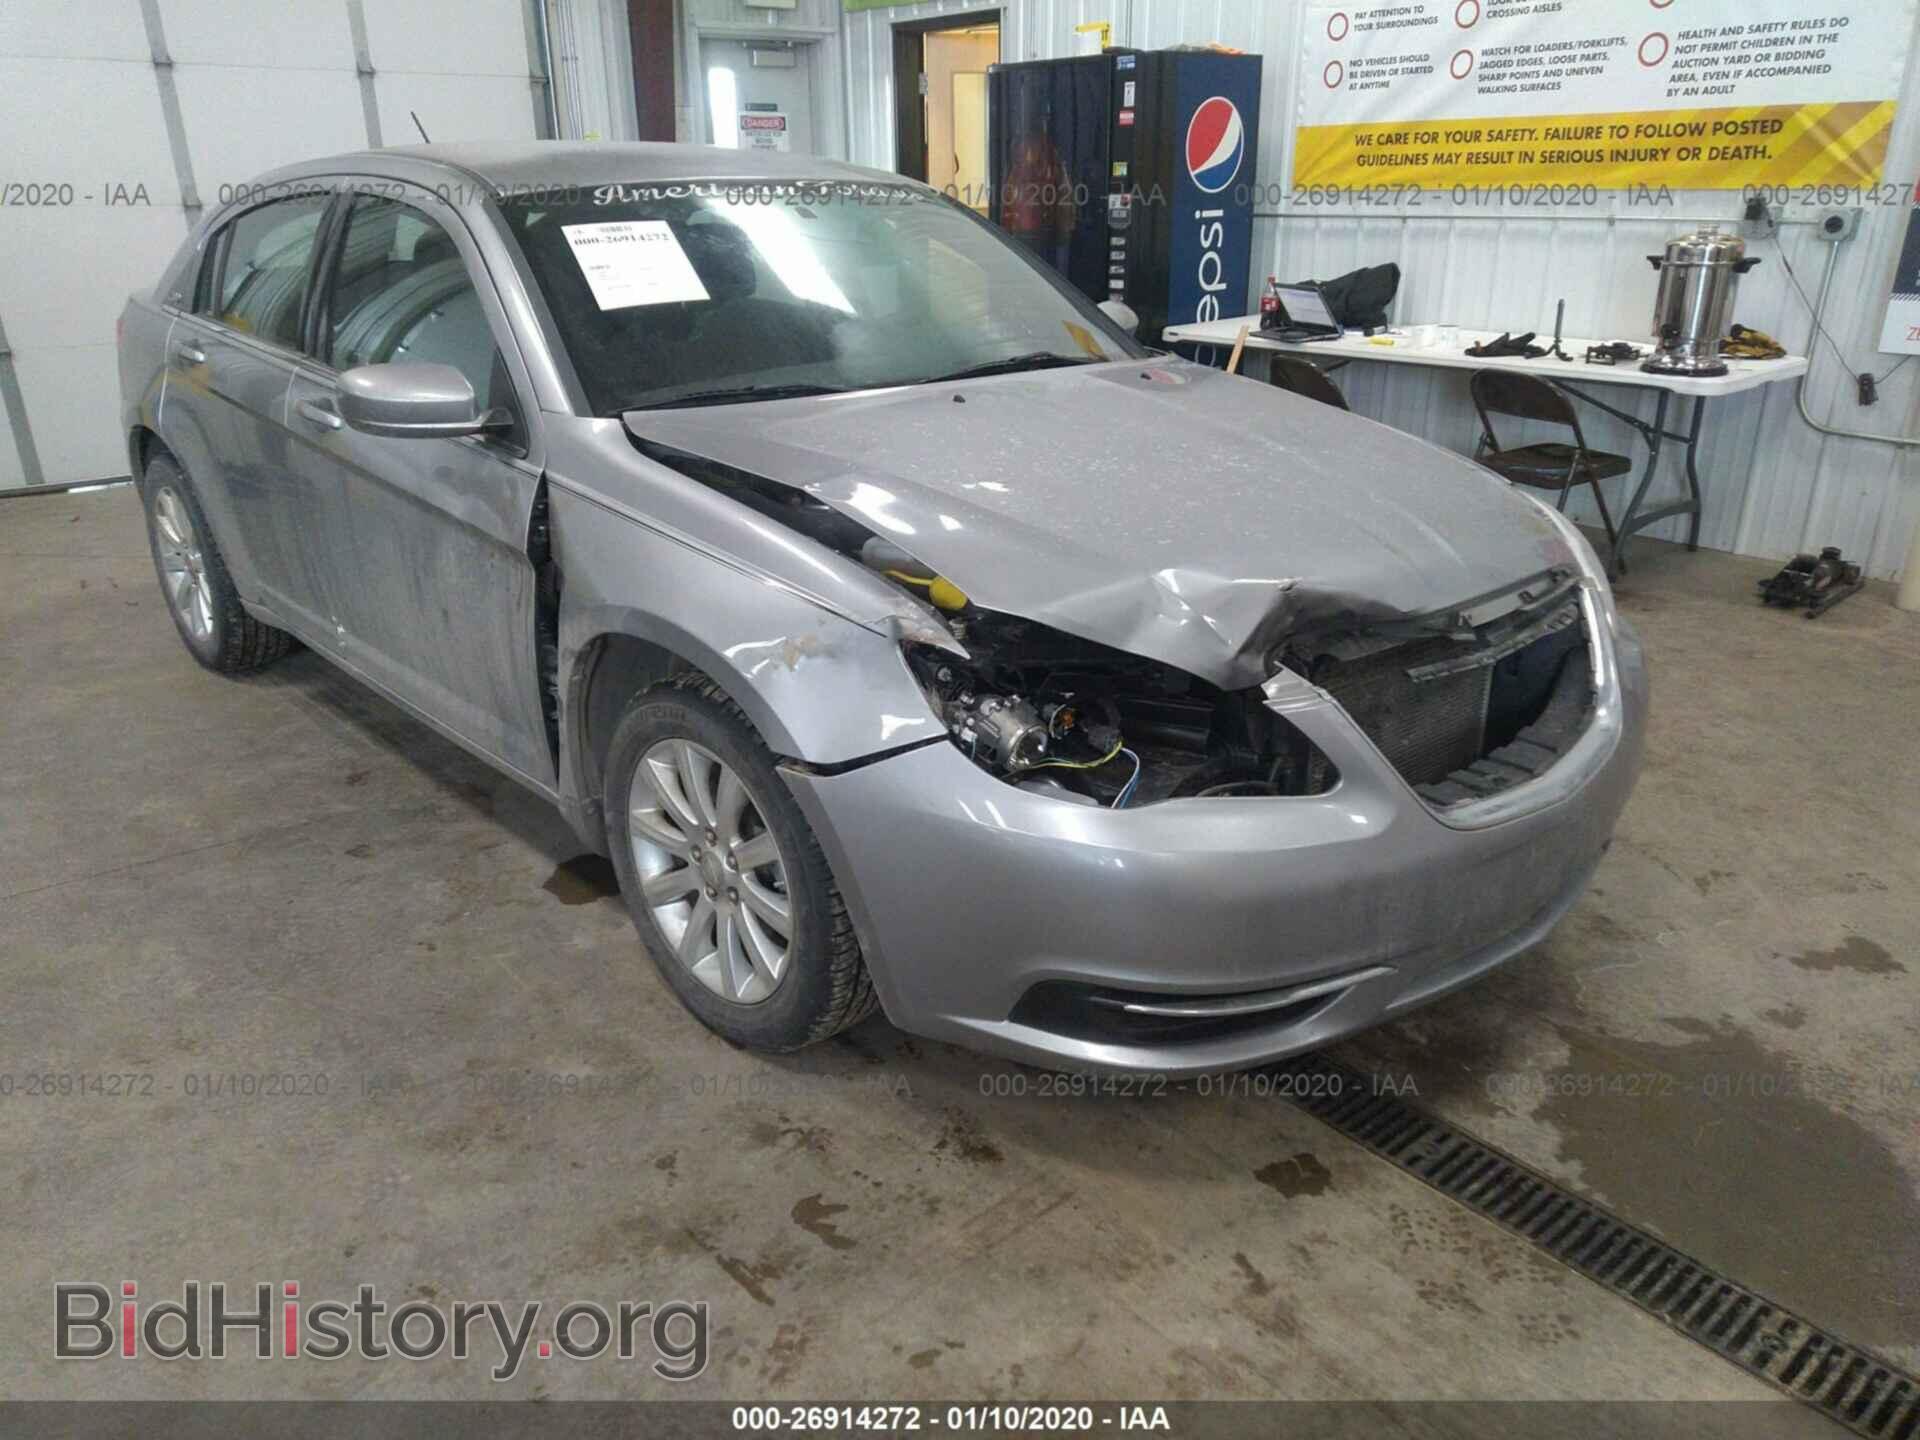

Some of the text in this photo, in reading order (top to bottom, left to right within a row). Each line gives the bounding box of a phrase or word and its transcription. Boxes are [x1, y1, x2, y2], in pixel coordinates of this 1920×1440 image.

[1355, 5, 1425, 21] PAY ATTENTION TO
[1486, 2, 1563, 19] CROSSING AISLES
[1354, 16, 1440, 32] YOUR SURROUNDINGS
[1677, 17, 1850, 41] HEALTH AND SAFETY RULES DO
[1481, 36, 1628, 57] WATCH FOR LOADERS/FORKLIFTS,
[1673, 32, 1841, 56] NOT PERMIT CHILDREN IN THE
[1349, 53, 1431, 68] NO VEHICLES SHOULD
[1478, 59, 1514, 71] JAGGED
[1548, 54, 1577, 65] LOOSE
[1671, 49, 1826, 70] AUCTION YARD OR BIDDING
[1349, 65, 1434, 80] BE DRIVEN OR STARTED
[1477, 65, 1604, 83] SHARP POINTS AND UNEVEN
[1668, 64, 1832, 85] AREA, EVEN IF ACCOMPANIED
[1349, 79, 1391, 91] AT ANYTIME
[1476, 81, 1562, 95] WALKING SURFACES
[1665, 83, 1737, 98] BY AN ADULT
[1355, 118, 1784, 147] WE CARE FOR YOUR SAFETY. FAILURE TO FOLLOW POSTED
[1355, 145, 1774, 168] GUIDELINES MAY RESULT IN SERIOUS INJURY OR DEATH.
